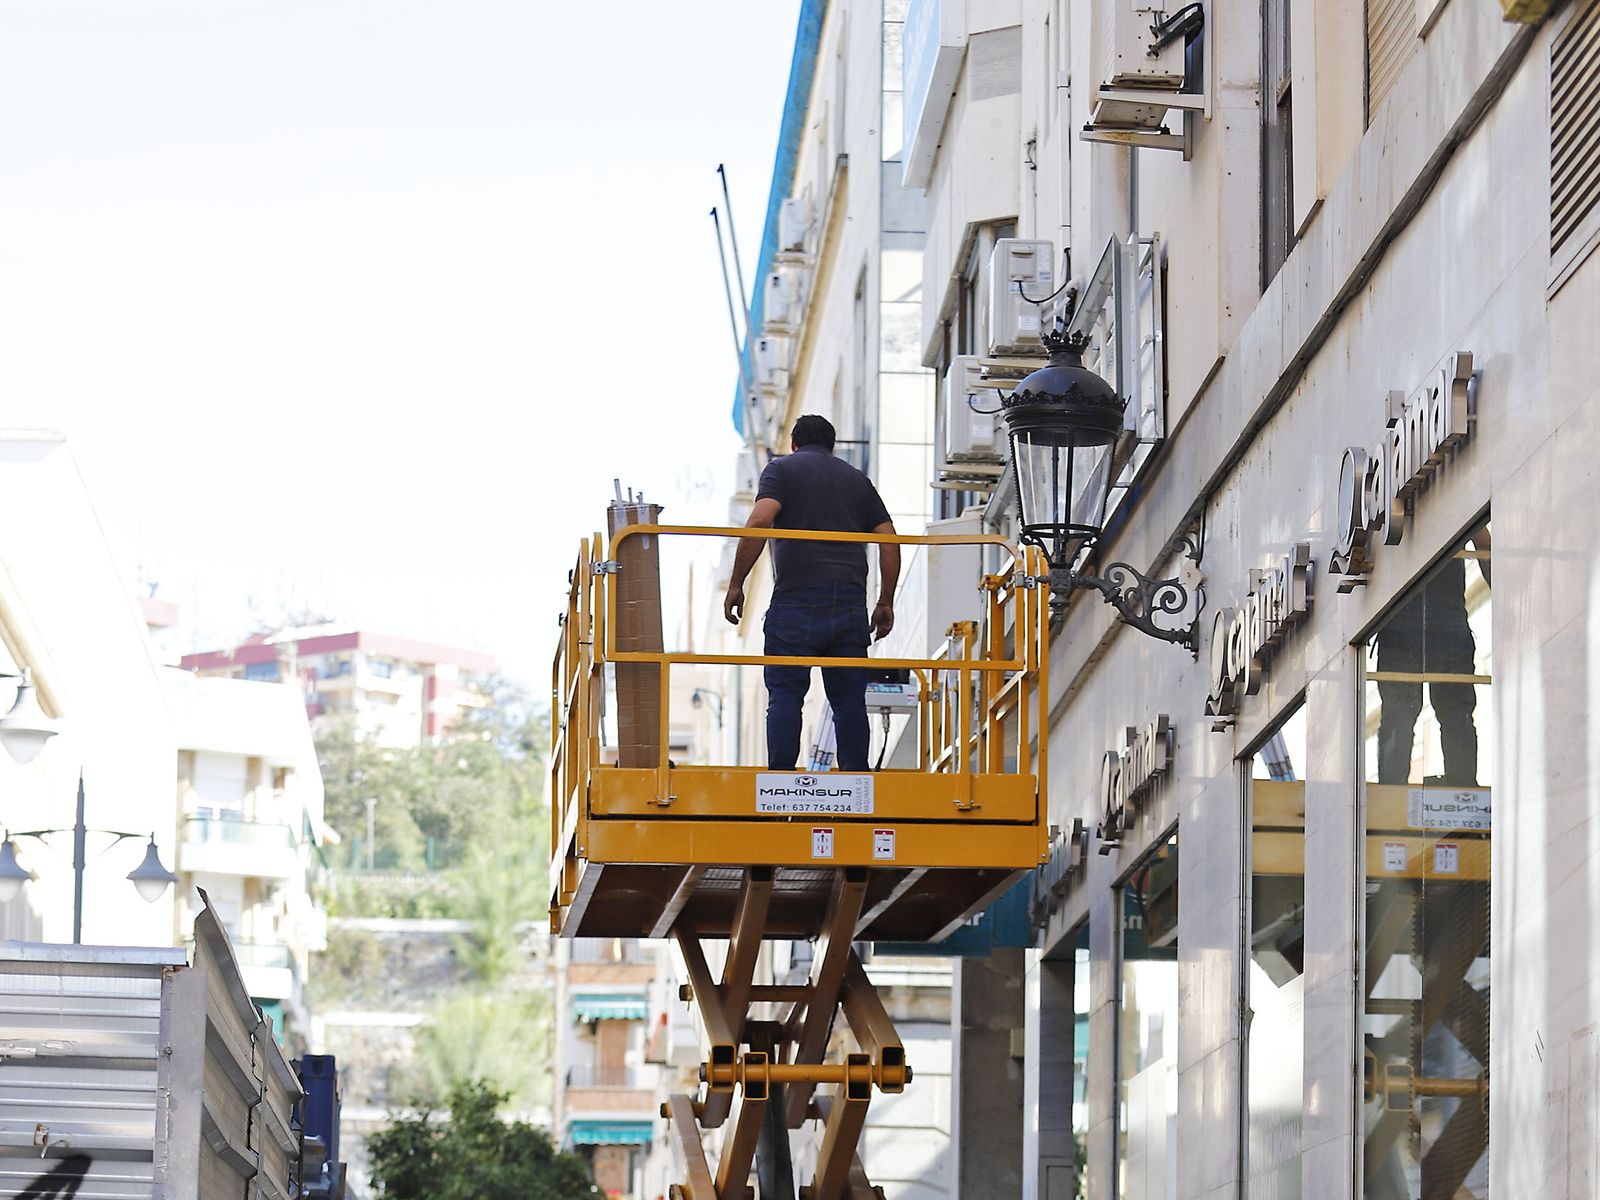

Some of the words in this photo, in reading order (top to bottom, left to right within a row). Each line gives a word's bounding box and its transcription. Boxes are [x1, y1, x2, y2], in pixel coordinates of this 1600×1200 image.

[760, 788, 852, 797] MAKINSUR
[761, 803, 790, 812] Telef:
[792, 803, 810, 812] 637
[814, 803, 831, 812] 754
[834, 804, 852, 812] 234
